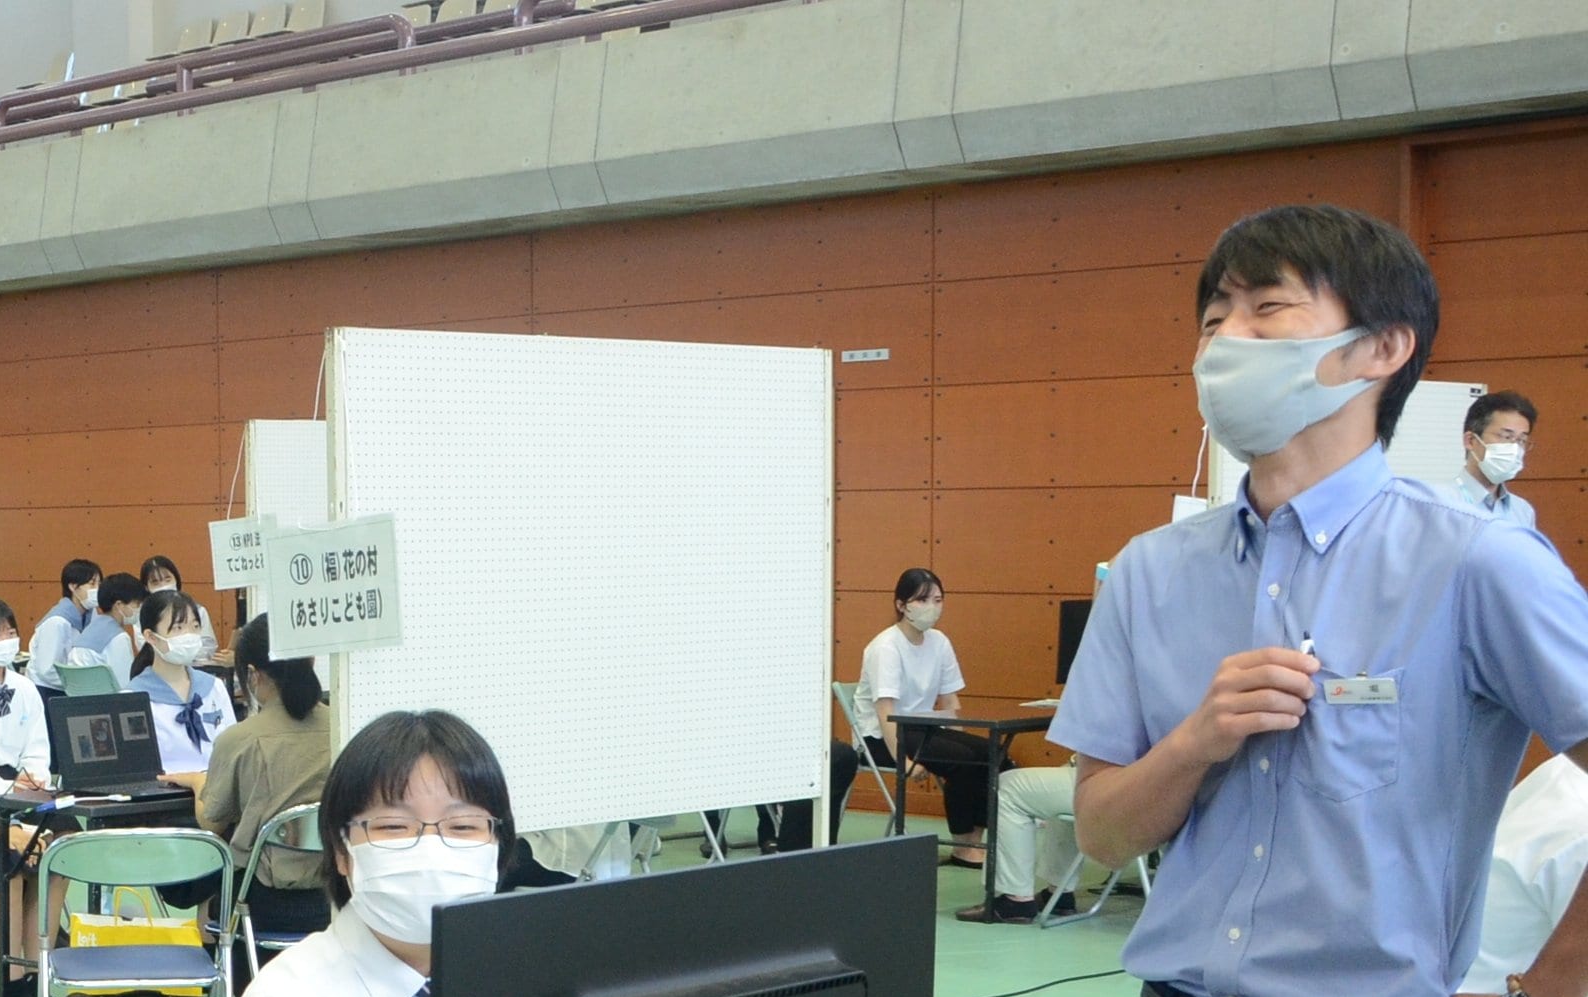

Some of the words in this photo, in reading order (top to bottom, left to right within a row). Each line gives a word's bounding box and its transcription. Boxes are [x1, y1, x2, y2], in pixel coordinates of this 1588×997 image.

[290, 587, 383, 630] (あさりこども園)
